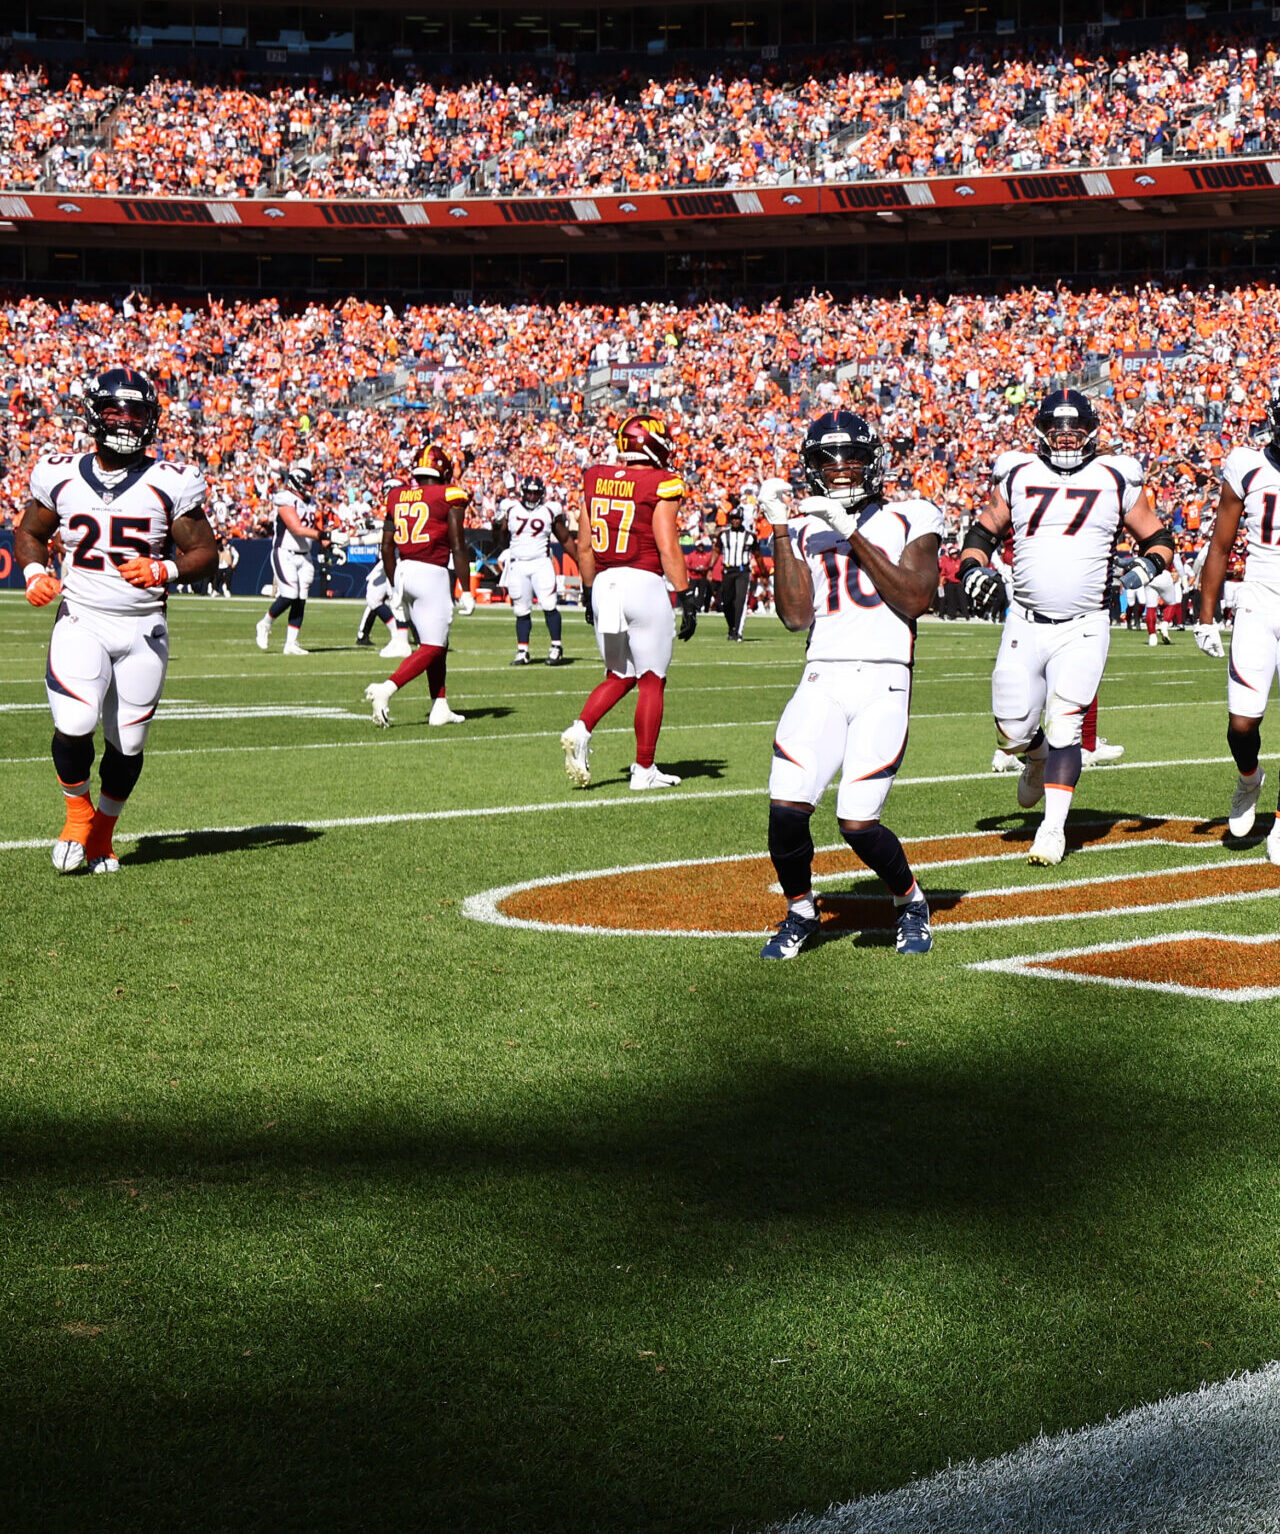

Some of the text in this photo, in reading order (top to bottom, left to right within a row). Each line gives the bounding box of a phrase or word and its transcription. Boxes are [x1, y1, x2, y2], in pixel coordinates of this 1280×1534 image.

[399, 489, 424, 502] DAVIS
[595, 478, 635, 498] BARTON
[393, 501, 430, 544] 52
[516, 516, 545, 537] 79
[591, 497, 636, 553] 57
[1025, 486, 1102, 537] 77
[68, 513, 152, 571] 25
